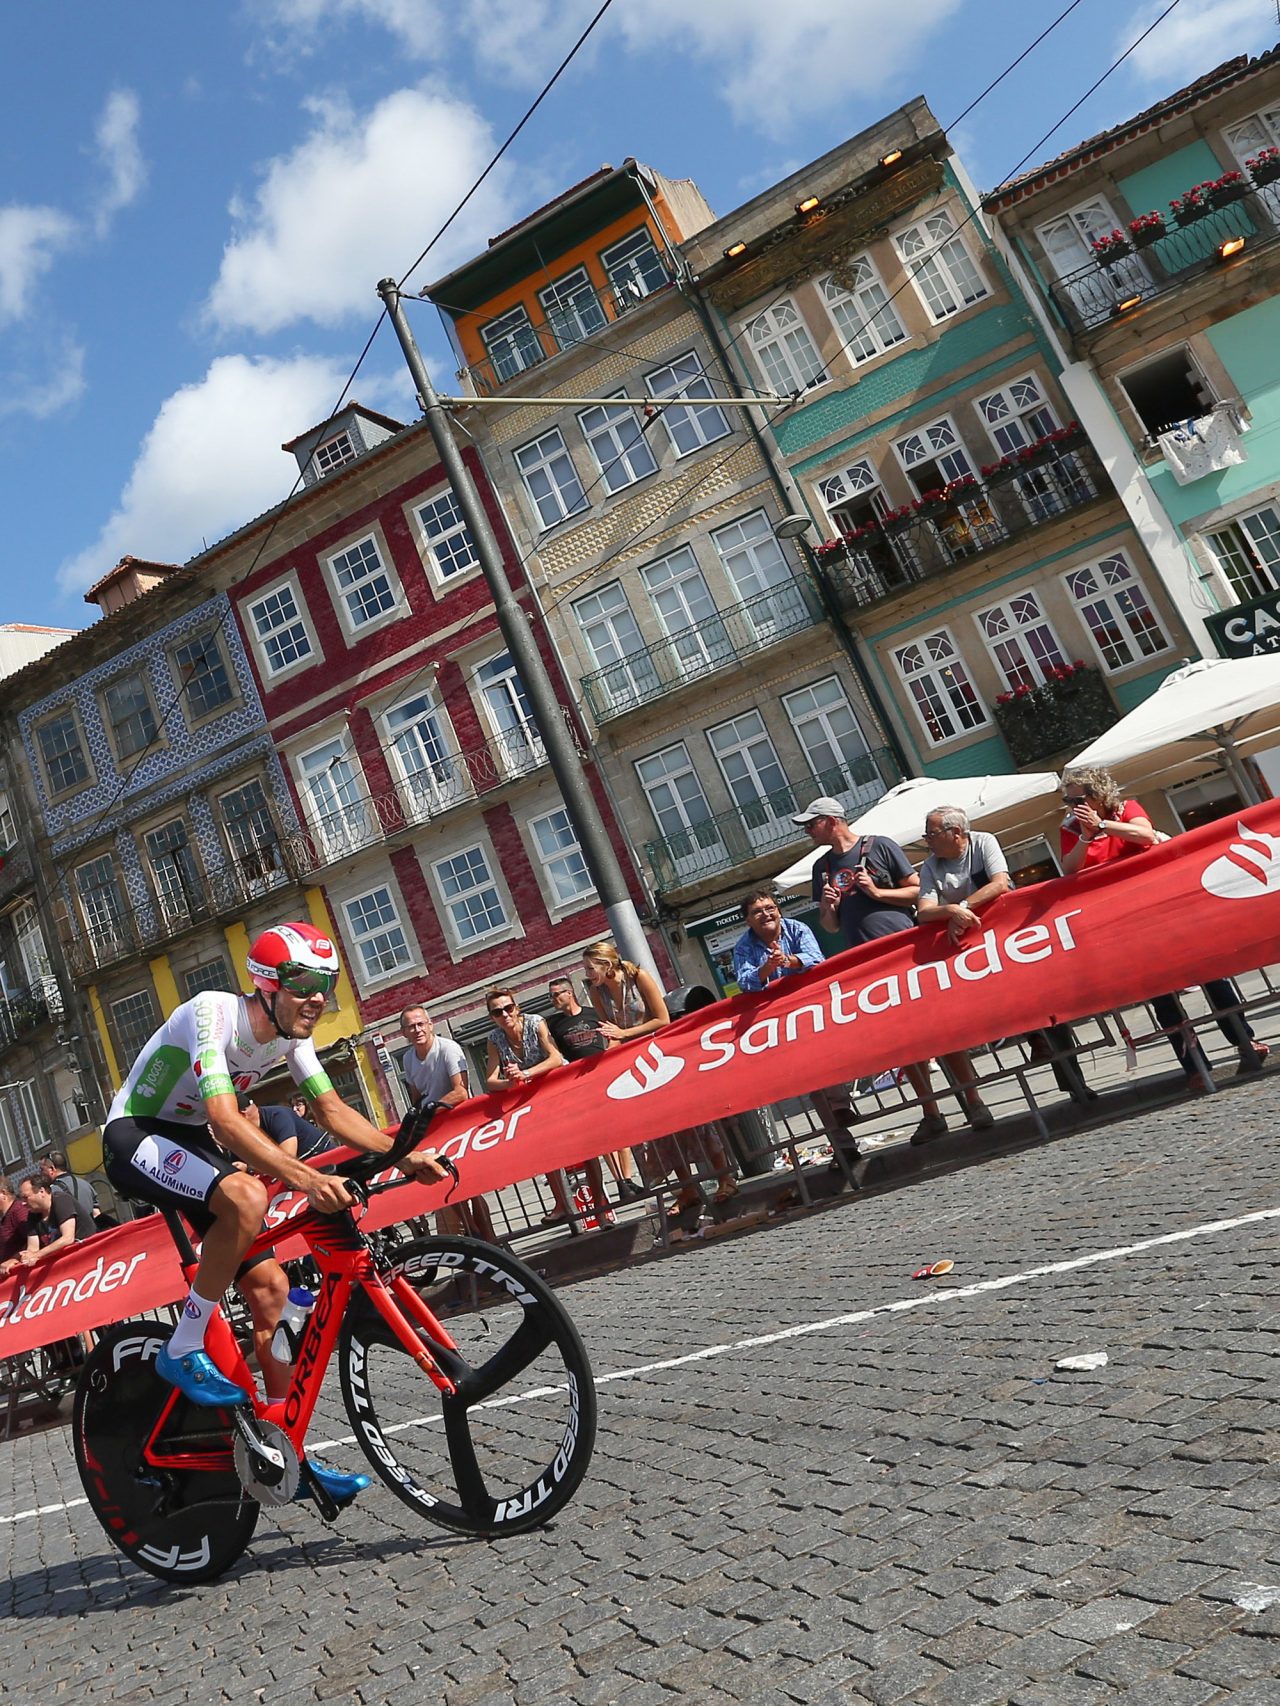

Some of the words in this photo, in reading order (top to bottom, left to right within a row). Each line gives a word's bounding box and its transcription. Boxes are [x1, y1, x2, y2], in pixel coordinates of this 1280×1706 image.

[697, 908, 1083, 1072] Santander
[146, 1057, 165, 1087] JOGOS
[133, 1153, 147, 1171] L.A.
[380, 1252, 466, 1288] SPEED
[471, 1256, 539, 1305] TRI
[284, 1272, 343, 1429] ORBEA
[348, 1335, 365, 1413] TRI
[361, 1420, 440, 1509] SPEED
[553, 1370, 579, 1483] SPEED
[493, 1484, 554, 1523] TRI
